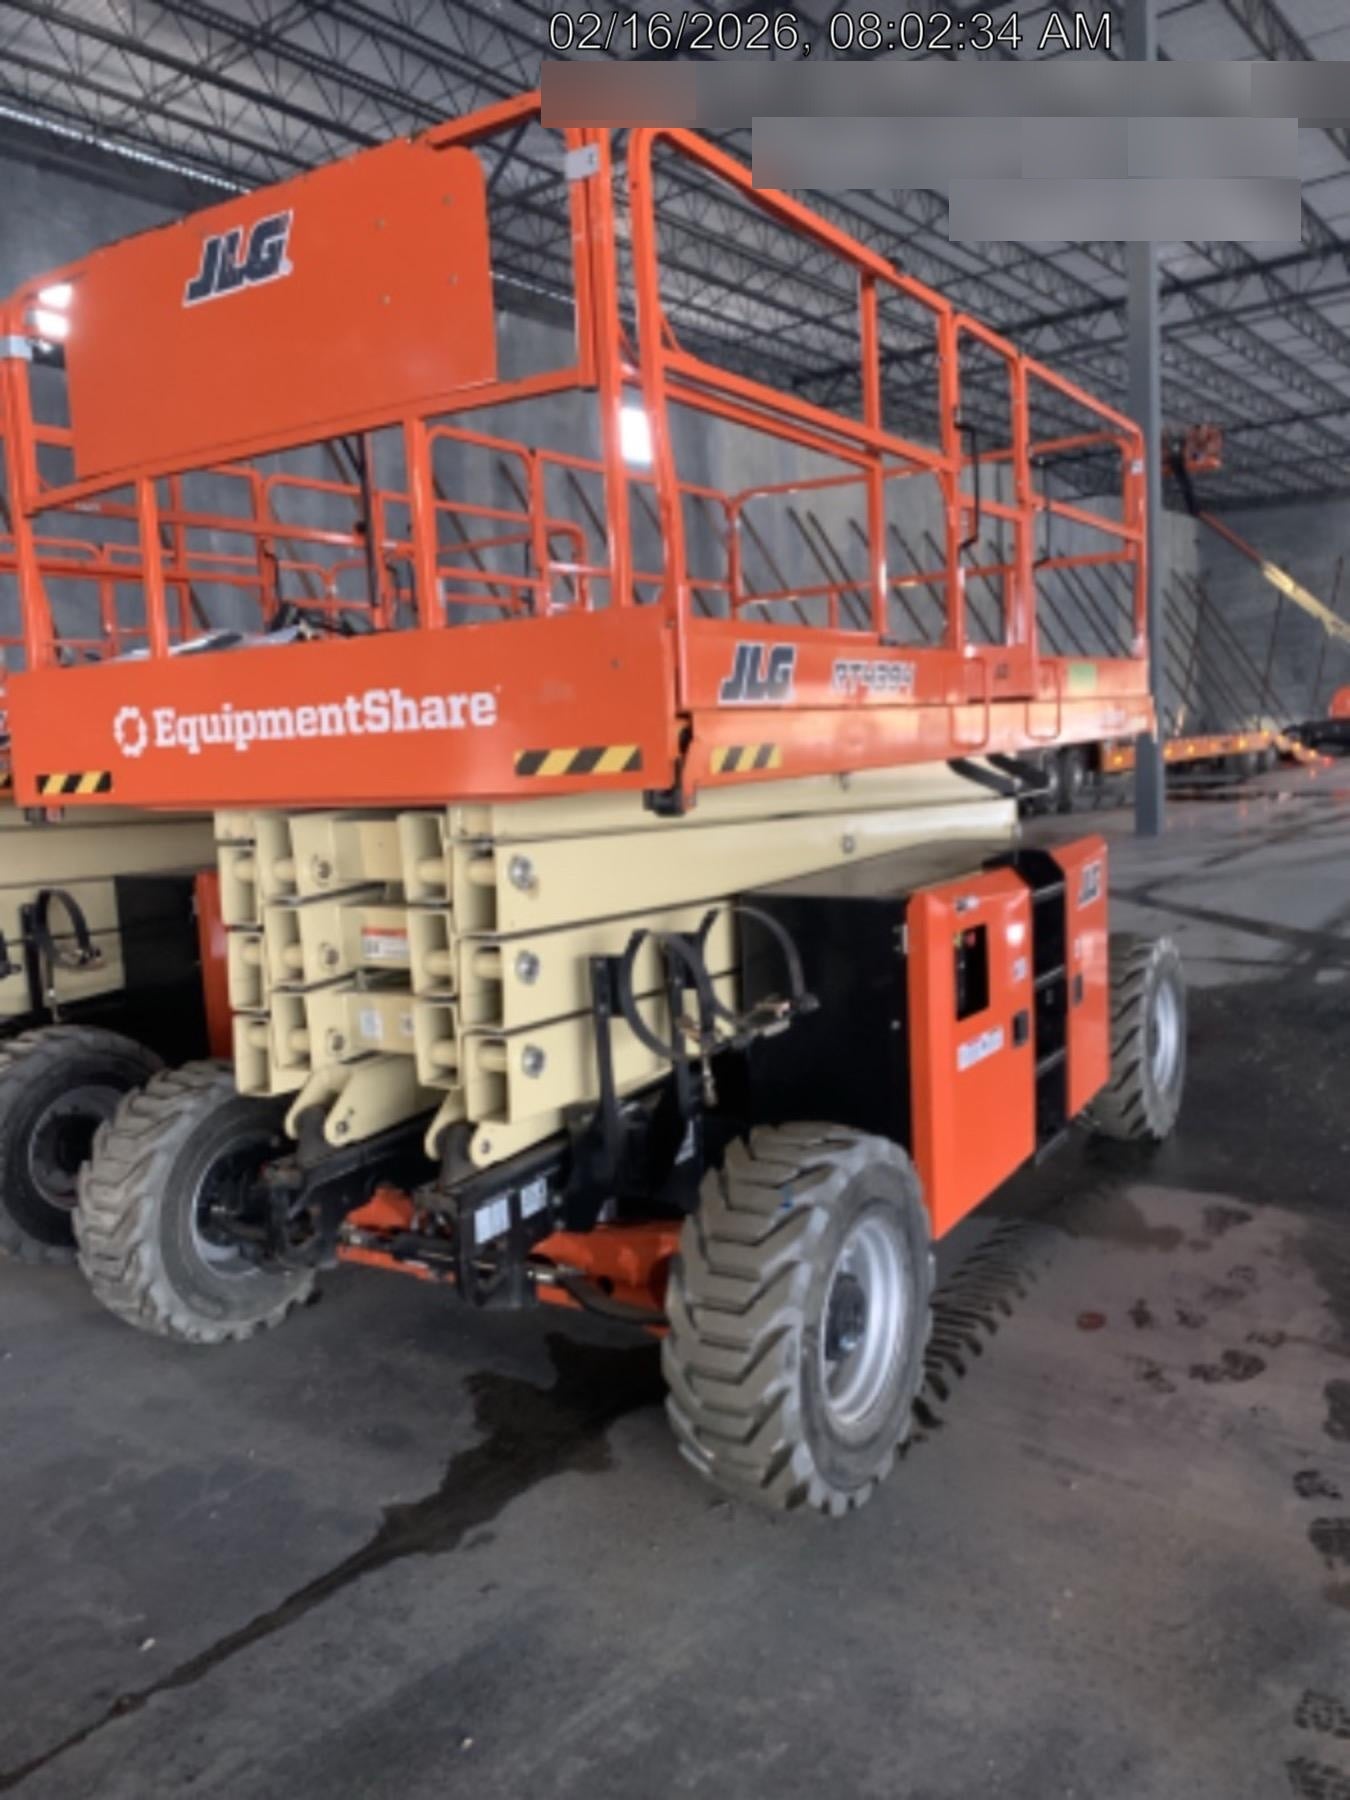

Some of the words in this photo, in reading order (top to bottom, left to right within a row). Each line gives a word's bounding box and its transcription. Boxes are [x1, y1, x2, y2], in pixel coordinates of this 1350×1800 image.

[184, 209, 293, 305] JLG
[719, 642, 796, 704] JLG
[153, 687, 498, 755] EquipmentShare
